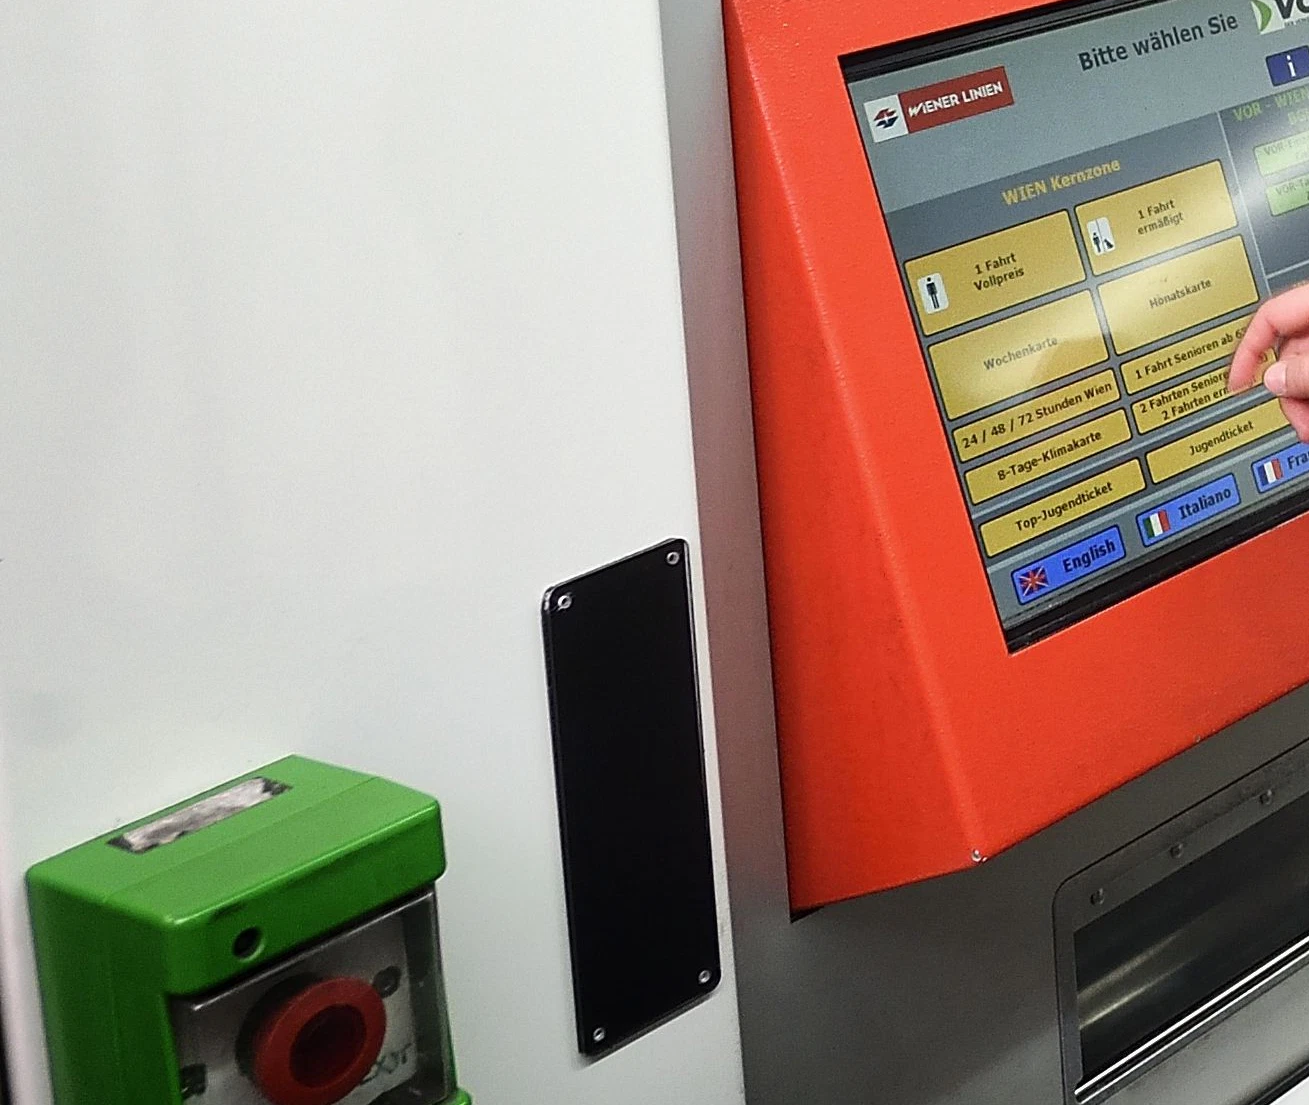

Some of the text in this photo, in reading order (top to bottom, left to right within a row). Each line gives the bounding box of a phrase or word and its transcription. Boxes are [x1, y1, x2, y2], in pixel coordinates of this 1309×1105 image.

[1078, 13, 1239, 72] Bitte wählen Sie
[908, 81, 1004, 118] WIENER LINIEN
[1232, 101, 1262, 121] VOR
[1001, 159, 1122, 206] WIEN Kernzone
[1137, 212, 1184, 236] ermäßigt
[1138, 199, 1176, 220] 1 Fahrt
[973, 267, 1025, 291] Vollpreis
[975, 253, 1017, 275] 1 Fahrt
[983, 336, 1058, 371] Wochenkarte
[1135, 369, 1143, 380] 1
[1144, 357, 1173, 376] Fahrt
[1174, 339, 1219, 361] Senioren
[1221, 333, 1234, 346] ab
[1140, 403, 1148, 414] 2
[1149, 387, 1190, 410] Fahrten
[1191, 373, 1229, 392] Seniore
[1161, 394, 1211, 421] 2 Fahrten
[962, 434, 978, 449] 24
[990, 423, 1006, 436] 48
[1018, 412, 1034, 426] 72
[1035, 395, 1083, 420] Stunden
[1083, 383, 1113, 400] Wien
[1188, 420, 1254, 456] Jugendticket
[997, 431, 1102, 481] 8-Tage-Klimakarte
[1015, 481, 1113, 532] Top-Jugendticket
[1178, 487, 1232, 520] Italiano
[1063, 539, 1116, 573] English
